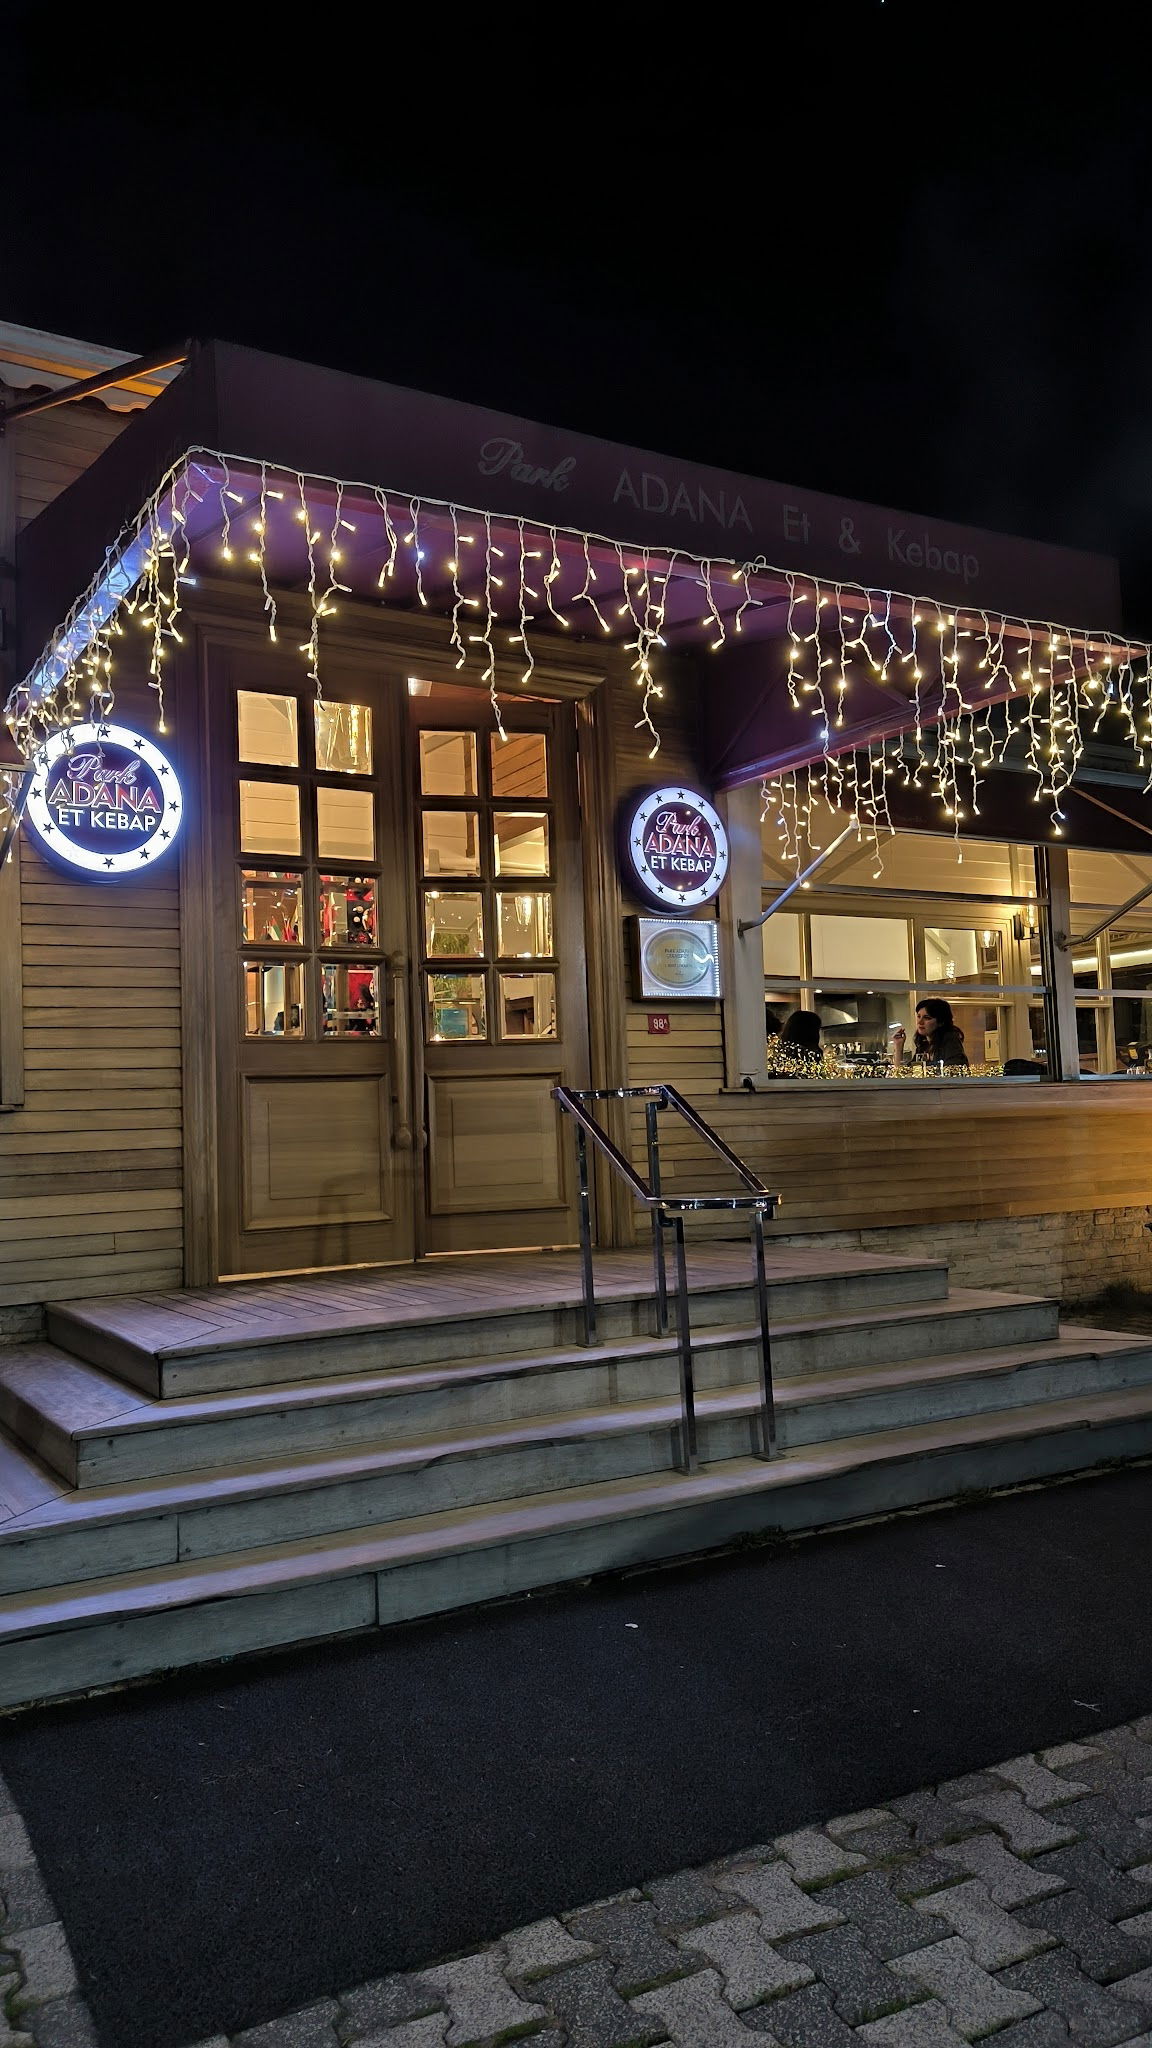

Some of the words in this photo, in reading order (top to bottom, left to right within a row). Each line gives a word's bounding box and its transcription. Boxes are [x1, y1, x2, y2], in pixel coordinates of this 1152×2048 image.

[478, 437, 577, 492] Park
[612, 467, 753, 533] ADANA
[783, 504, 811, 544] Et
[838, 517, 862, 554] &
[887, 527, 979, 584] Kebap
[67, 753, 141, 785] Park
[48, 778, 162, 814] ADANA
[57, 808, 84, 827] ET
[90, 810, 157, 832] KEBAP
[655, 811, 702, 837] Park
[644, 832, 715, 859] ADANA
[651, 855, 668, 870] ET
[671, 857, 712, 873] KEBAP
